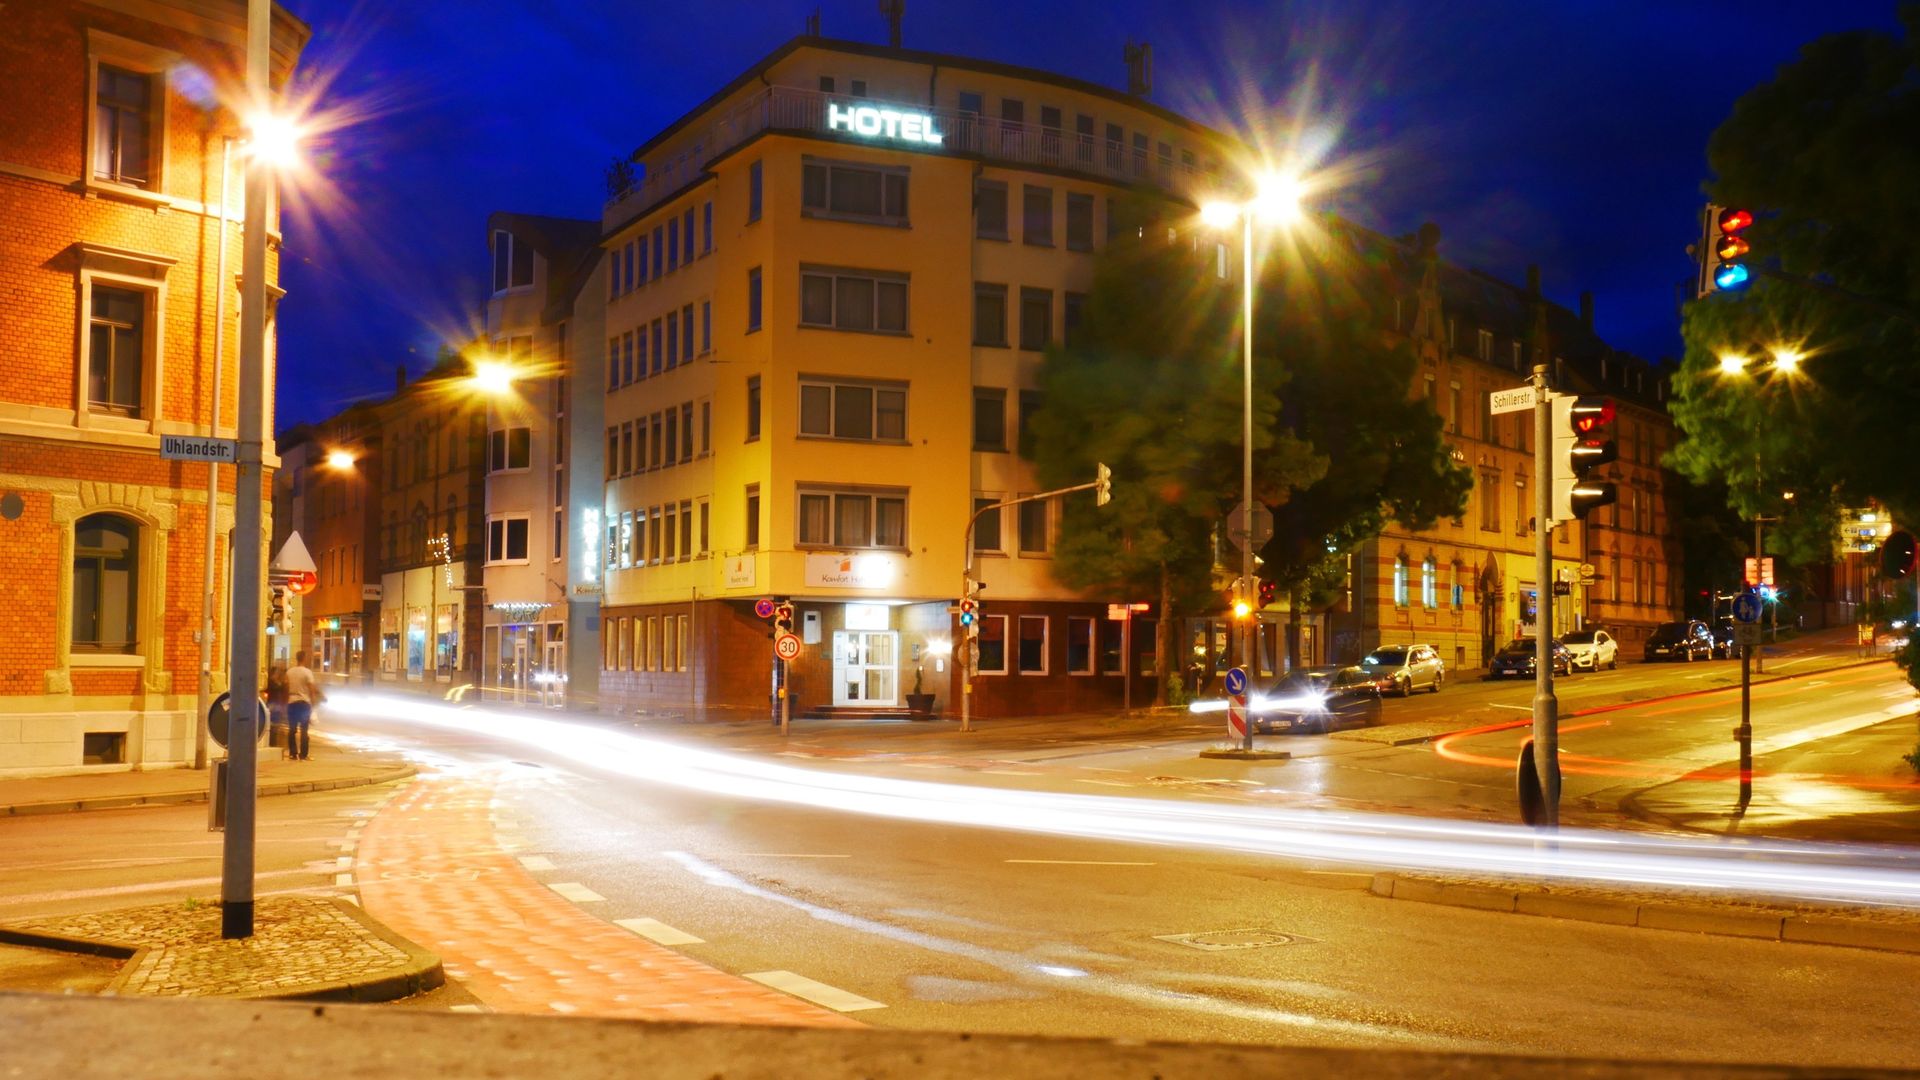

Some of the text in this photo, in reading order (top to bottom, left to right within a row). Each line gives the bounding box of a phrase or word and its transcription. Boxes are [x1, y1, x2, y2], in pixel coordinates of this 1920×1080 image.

[828, 103, 943, 144] HOTEL
[1493, 392, 1533, 408] Schillerstr.
[165, 438, 230, 457] Uhlandstr.
[781, 641, 796, 653] 30
